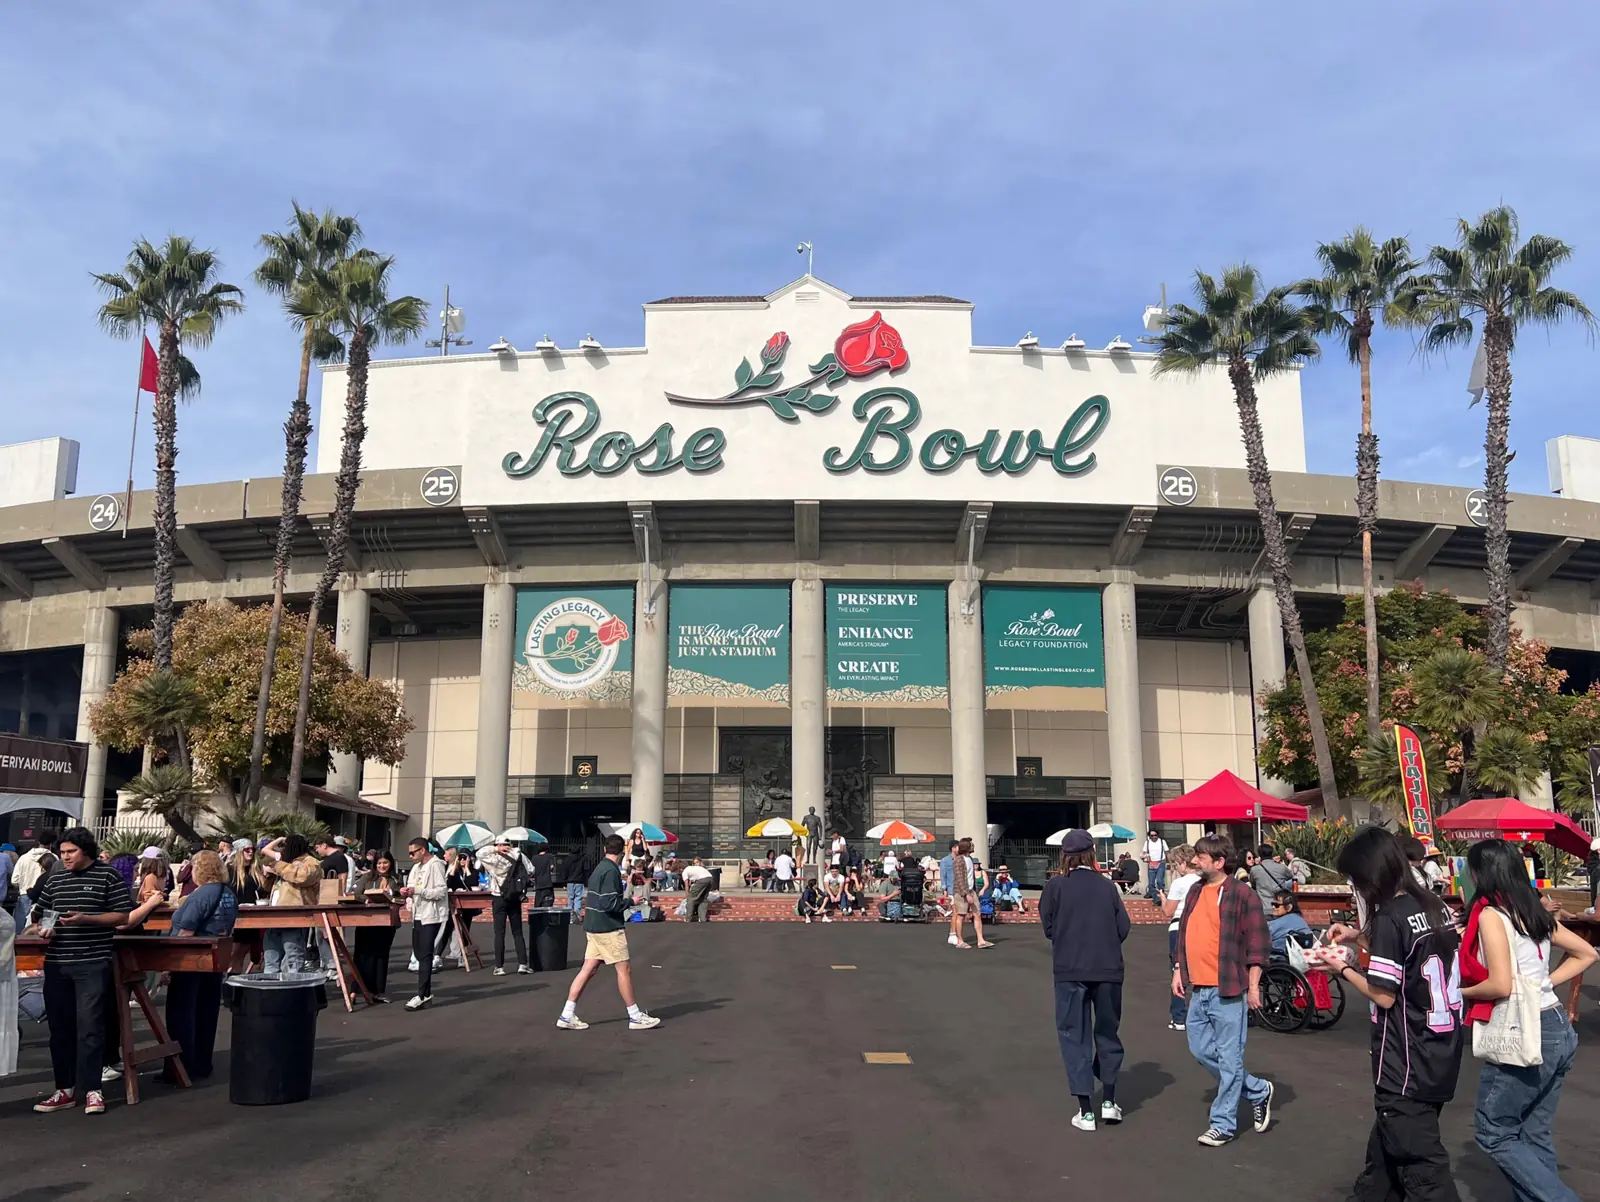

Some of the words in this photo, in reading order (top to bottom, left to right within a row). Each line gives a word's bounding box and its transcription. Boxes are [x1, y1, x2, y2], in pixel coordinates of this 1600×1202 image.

[501, 390, 726, 476] Rose
[822, 387, 1110, 473] Bowl
[425, 476, 454, 497] 25
[1163, 476, 1193, 496] 26
[92, 502, 115, 523] 24
[837, 593, 918, 606] PRESERVE
[530, 606, 561, 650] LASTING
[561, 602, 607, 621] LEGACY
[678, 625, 705, 635] THE
[703, 623, 739, 638] Rose
[739, 623, 784, 639] Bowl
[838, 626, 913, 639] ENHANCE
[1003, 621, 1040, 636] Rose
[1040, 622, 1083, 637] Bowl
[679, 636, 690, 645] IS
[693, 636, 729, 645] MORE
[733, 636, 767, 645] THAN
[999, 640, 1031, 648] LEGACY
[1033, 640, 1088, 649] FOUNDATION
[678, 647, 707, 657] JUST
[709, 647, 717, 656] A
[720, 647, 776, 656] STADIUM
[837, 660, 899, 673] CREATE
[41, 759, 72, 774] BOWLS
[579, 765, 590, 774] 25
[1024, 766, 1036, 776] 26
[1451, 830, 1480, 839] ITALIAN
